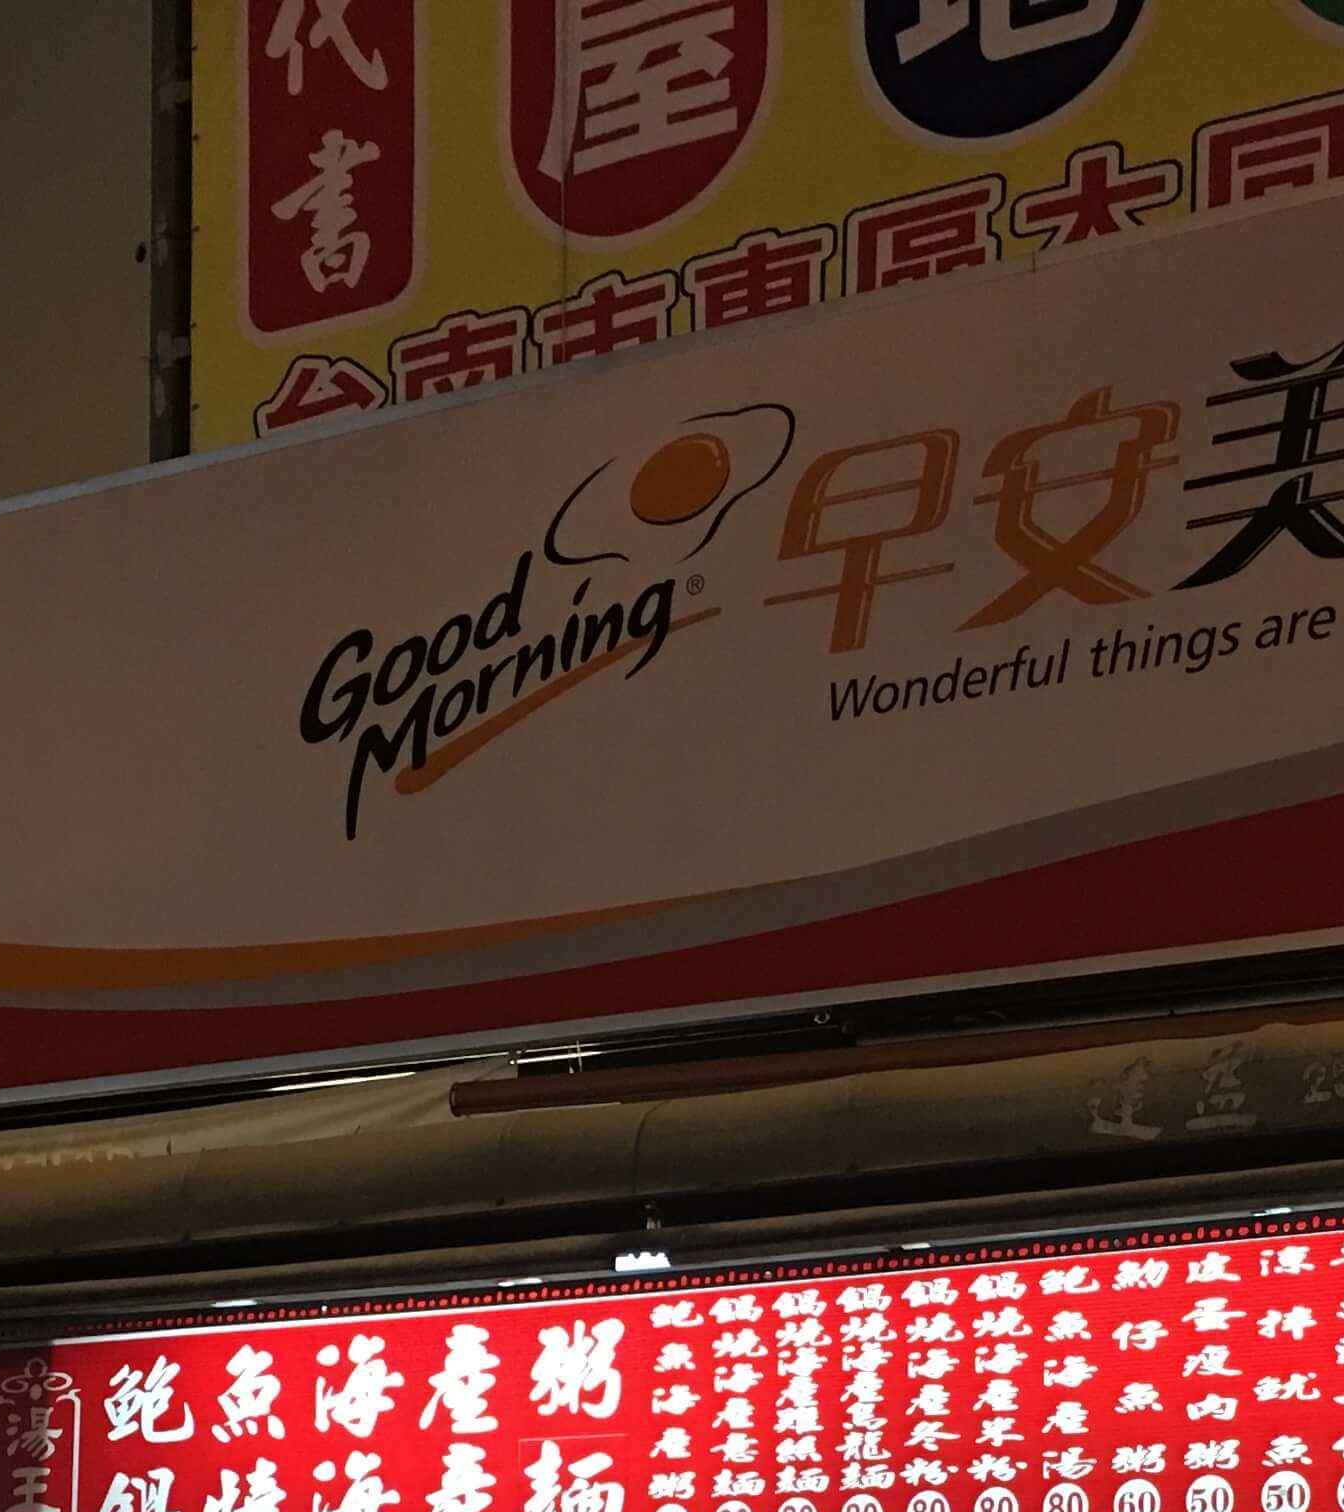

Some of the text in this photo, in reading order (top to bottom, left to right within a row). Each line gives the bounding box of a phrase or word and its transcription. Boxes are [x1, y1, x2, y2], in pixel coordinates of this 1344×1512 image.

[299, 551, 535, 746] Good
[344, 577, 678, 842] Morning
[828, 637, 1070, 722] Wonderful
[1088, 612, 1242, 680] things
[1253, 600, 1338, 648] are
[102, 1319, 626, 1445] 鮑魚海產粥
[1266, 1483, 1306, 1511] 50
